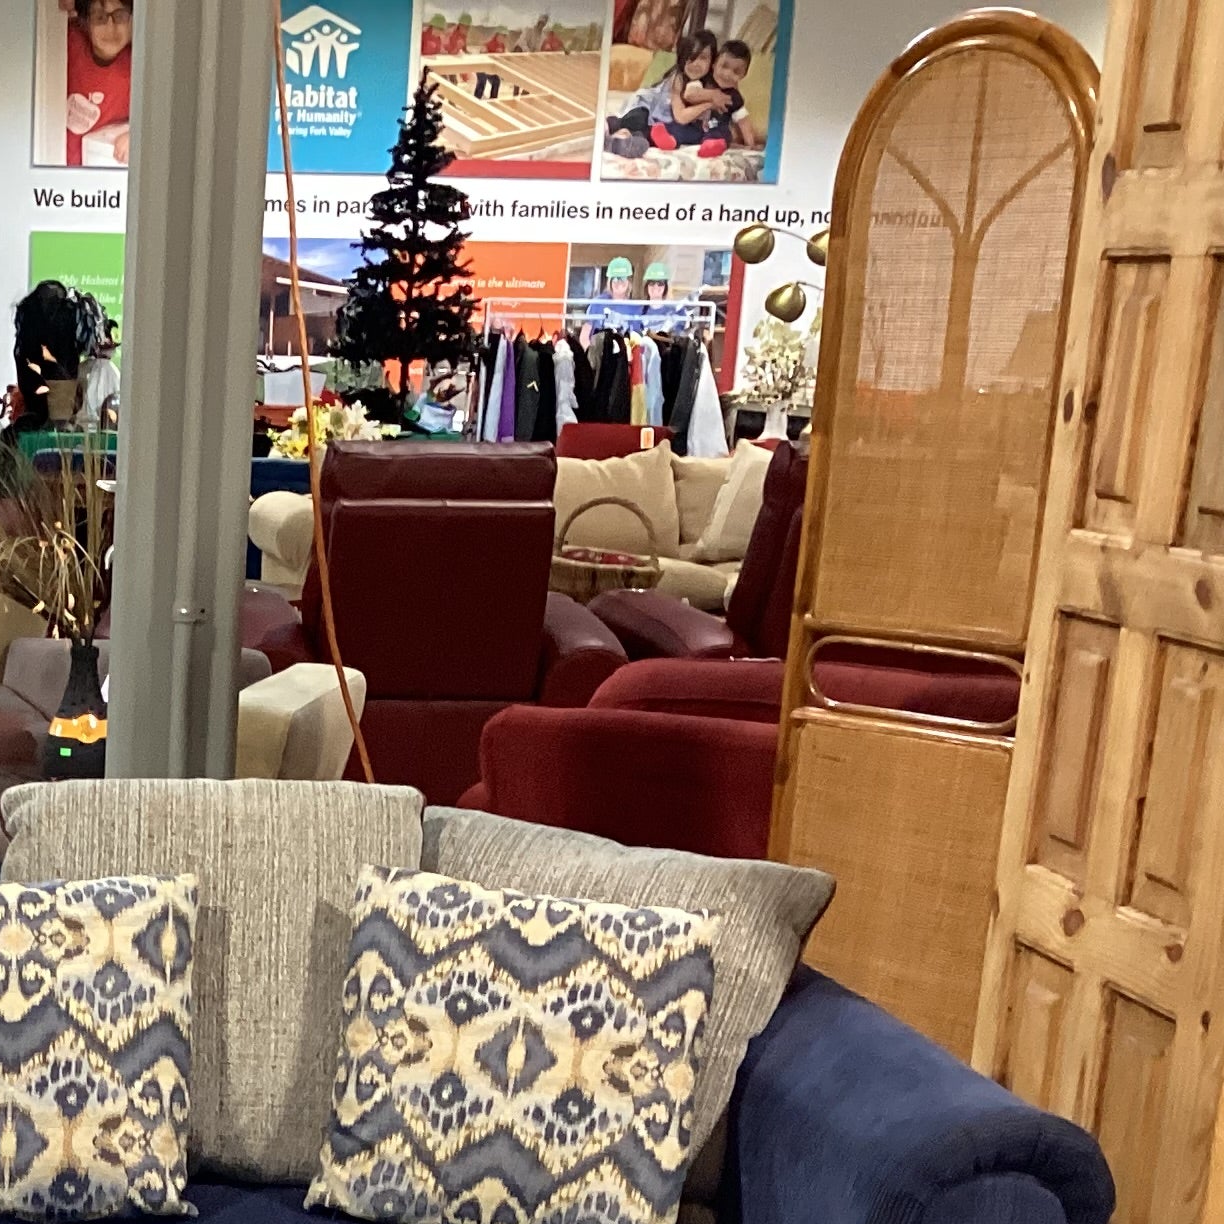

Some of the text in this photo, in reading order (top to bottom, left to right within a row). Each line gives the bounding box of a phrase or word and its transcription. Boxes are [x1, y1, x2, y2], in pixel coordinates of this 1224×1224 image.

[275, 84, 358, 109] Habitat
[34, 188, 65, 208] We
[71, 190, 122, 208] build
[313, 195, 330, 213] in
[511, 199, 590, 219] families
[596, 201, 613, 219] in
[619, 203, 670, 221] need
[675, 203, 696, 221] of
[702, 207, 713, 222] a
[719, 204, 769, 223] hand
[775, 210, 804, 227] up,
[488, 276, 504, 289] the
[505, 276, 546, 289] ultimate
